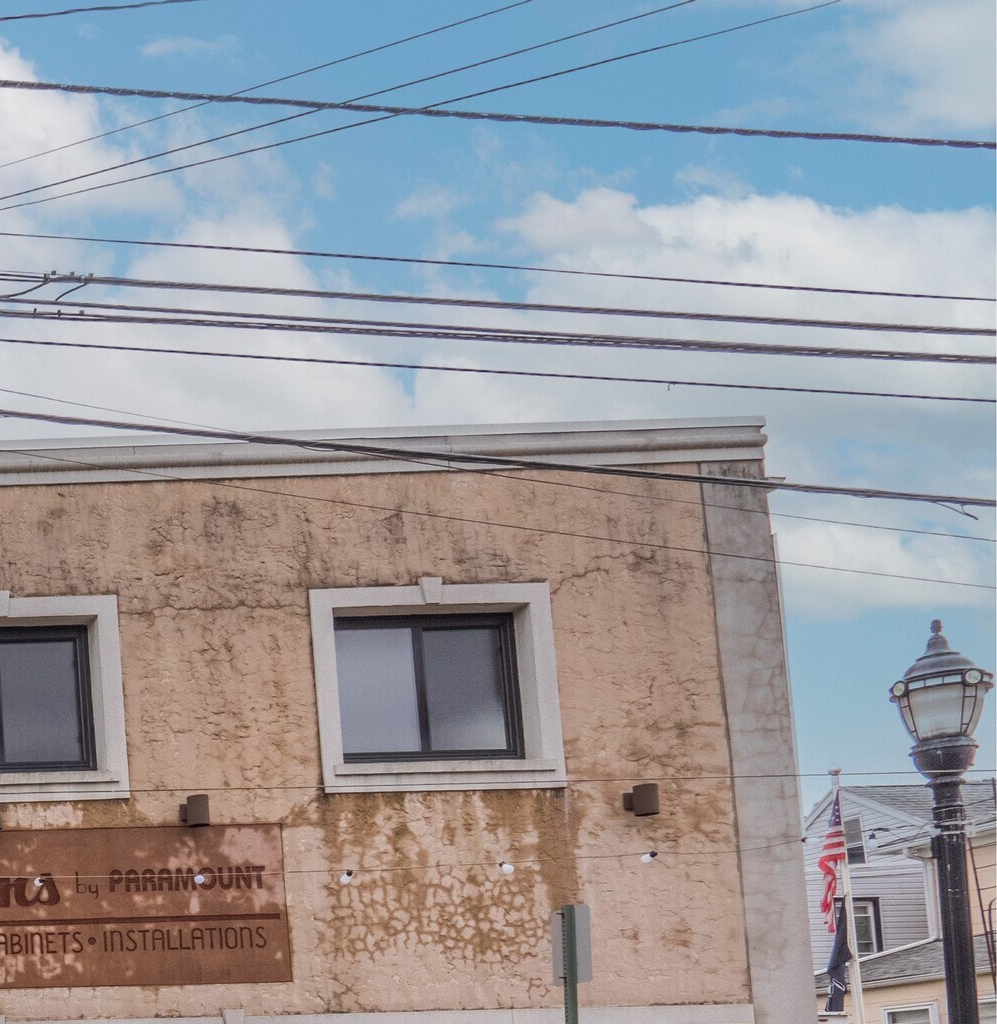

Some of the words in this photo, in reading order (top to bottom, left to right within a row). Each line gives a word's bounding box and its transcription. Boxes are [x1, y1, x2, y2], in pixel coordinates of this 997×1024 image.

[75, 871, 99, 899] by
[109, 865, 266, 893] PARAMOUNT
[103, 926, 268, 952] INSTALLATIONS
